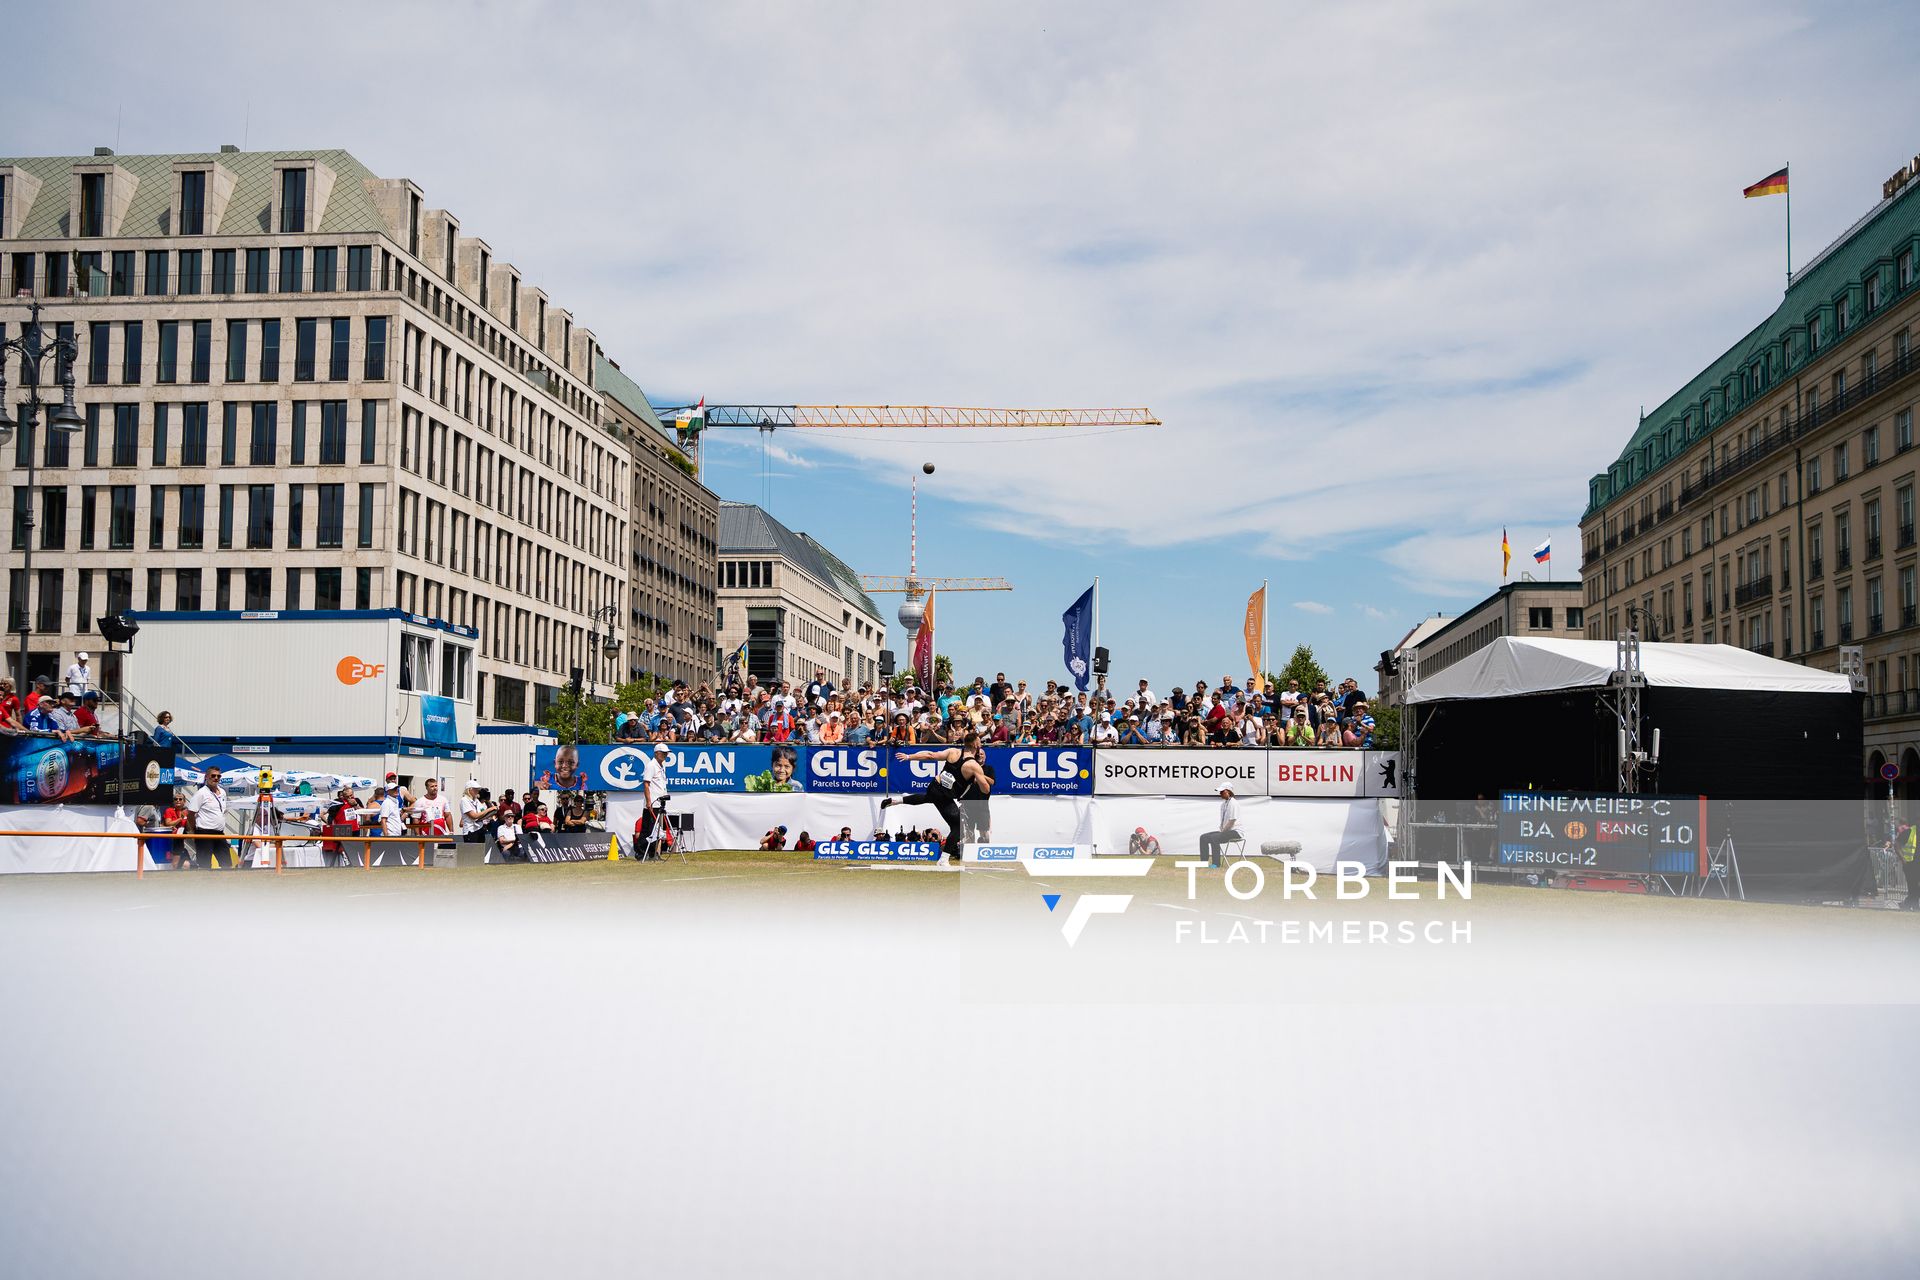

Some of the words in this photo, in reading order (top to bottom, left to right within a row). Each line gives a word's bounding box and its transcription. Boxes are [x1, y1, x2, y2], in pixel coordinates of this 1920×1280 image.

[352, 664, 385, 678] ZDF
[1104, 764, 1256, 779] SPORTMETROPOLE
[1278, 764, 1354, 782] BERLIN
[813, 780, 840, 788] Parcels
[851, 781, 878, 790] People
[1011, 781, 1039, 789] Parcels
[1051, 782, 1079, 791] People
[1520, 820, 1555, 838] BA
[1599, 822, 1649, 836] RANG
[1660, 825, 1694, 845] 10
[536, 847, 586, 863] NOVAFON
